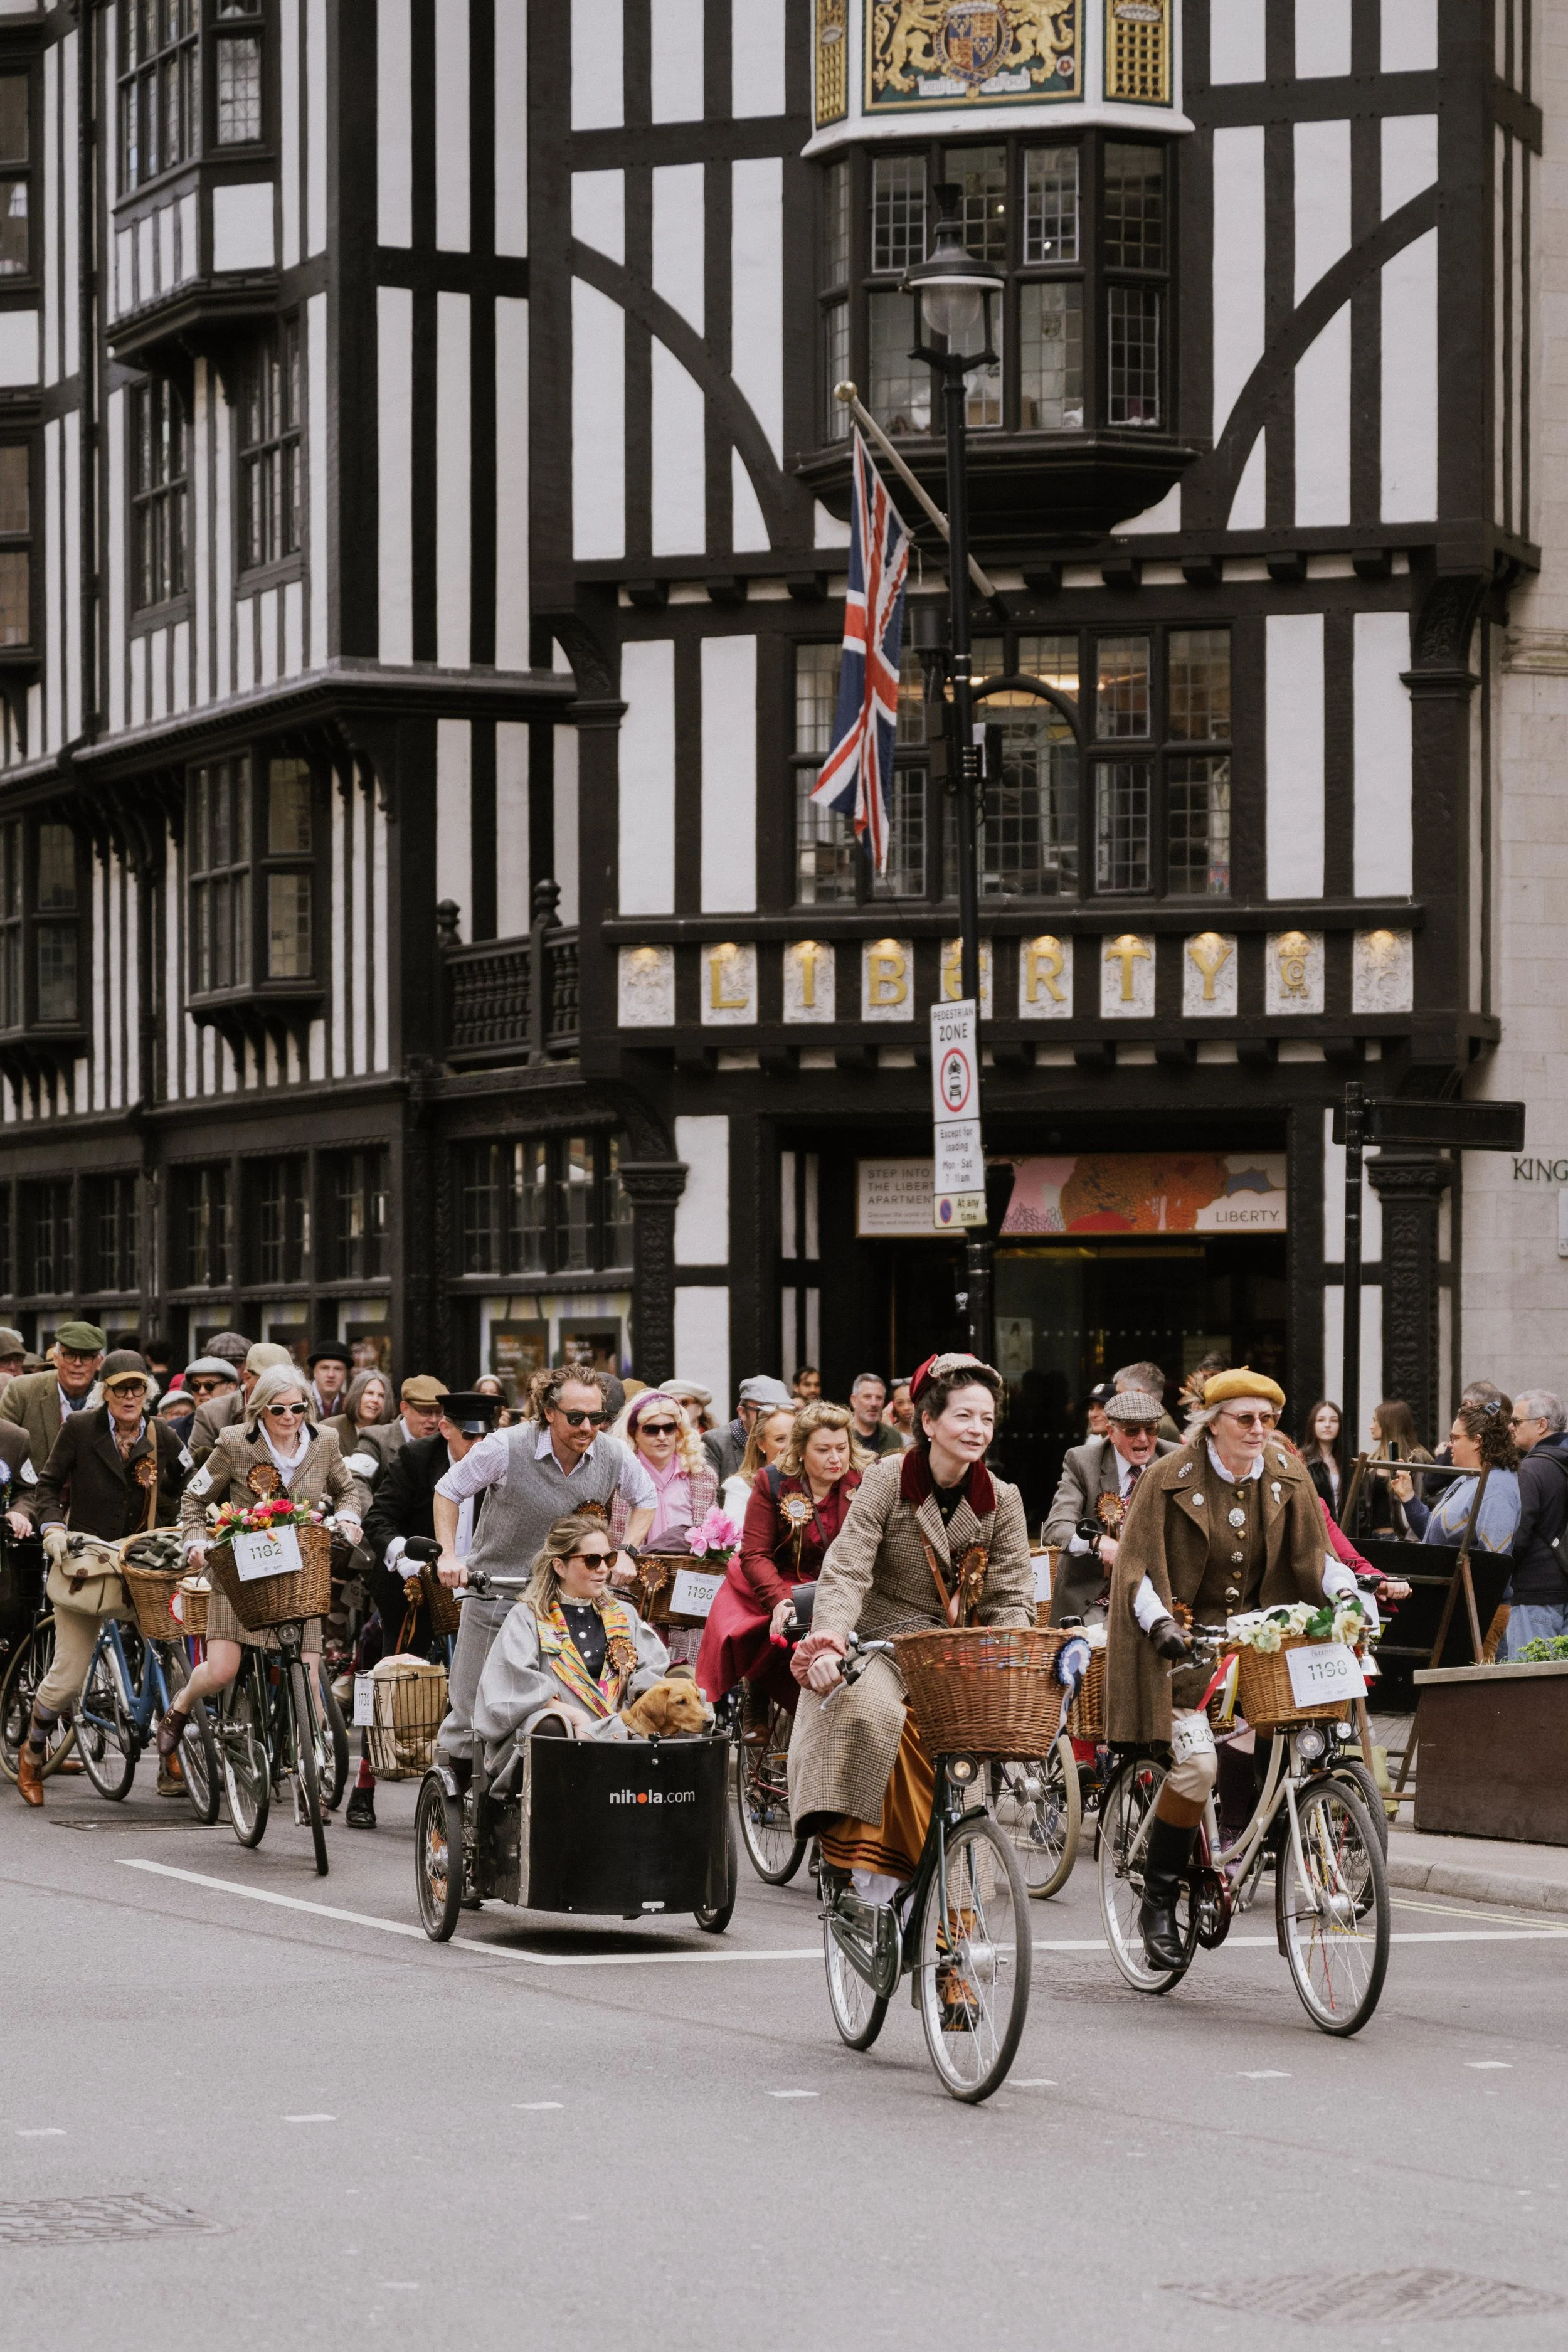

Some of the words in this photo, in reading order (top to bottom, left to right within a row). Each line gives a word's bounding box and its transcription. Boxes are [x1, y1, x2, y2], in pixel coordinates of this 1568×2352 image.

[709, 947, 1233, 1009] LIBERTY
[1279, 986, 1310, 999] LTD
[933, 1006, 974, 1022] PEDESTRIAN
[939, 1022, 968, 1042] ZONE
[940, 1128, 962, 1140] Except
[963, 1126, 973, 1136] for
[945, 1141, 969, 1152] loading
[943, 1160, 956, 1170] Mon
[961, 1158, 973, 1168] Sat
[1511, 1156, 1568, 1182] KING
[867, 1168, 898, 1179] STEP
[902, 1168, 931, 1178] INTO
[867, 1182, 891, 1192] THE
[957, 1197, 965, 1207] At
[967, 1199, 980, 1208] any
[961, 1211, 977, 1222] time
[248, 1542, 282, 1560] 1182
[687, 1585, 714, 1600] 1196
[1308, 1660, 1347, 1680] 1198
[609, 1789, 696, 1804] nihola.com
